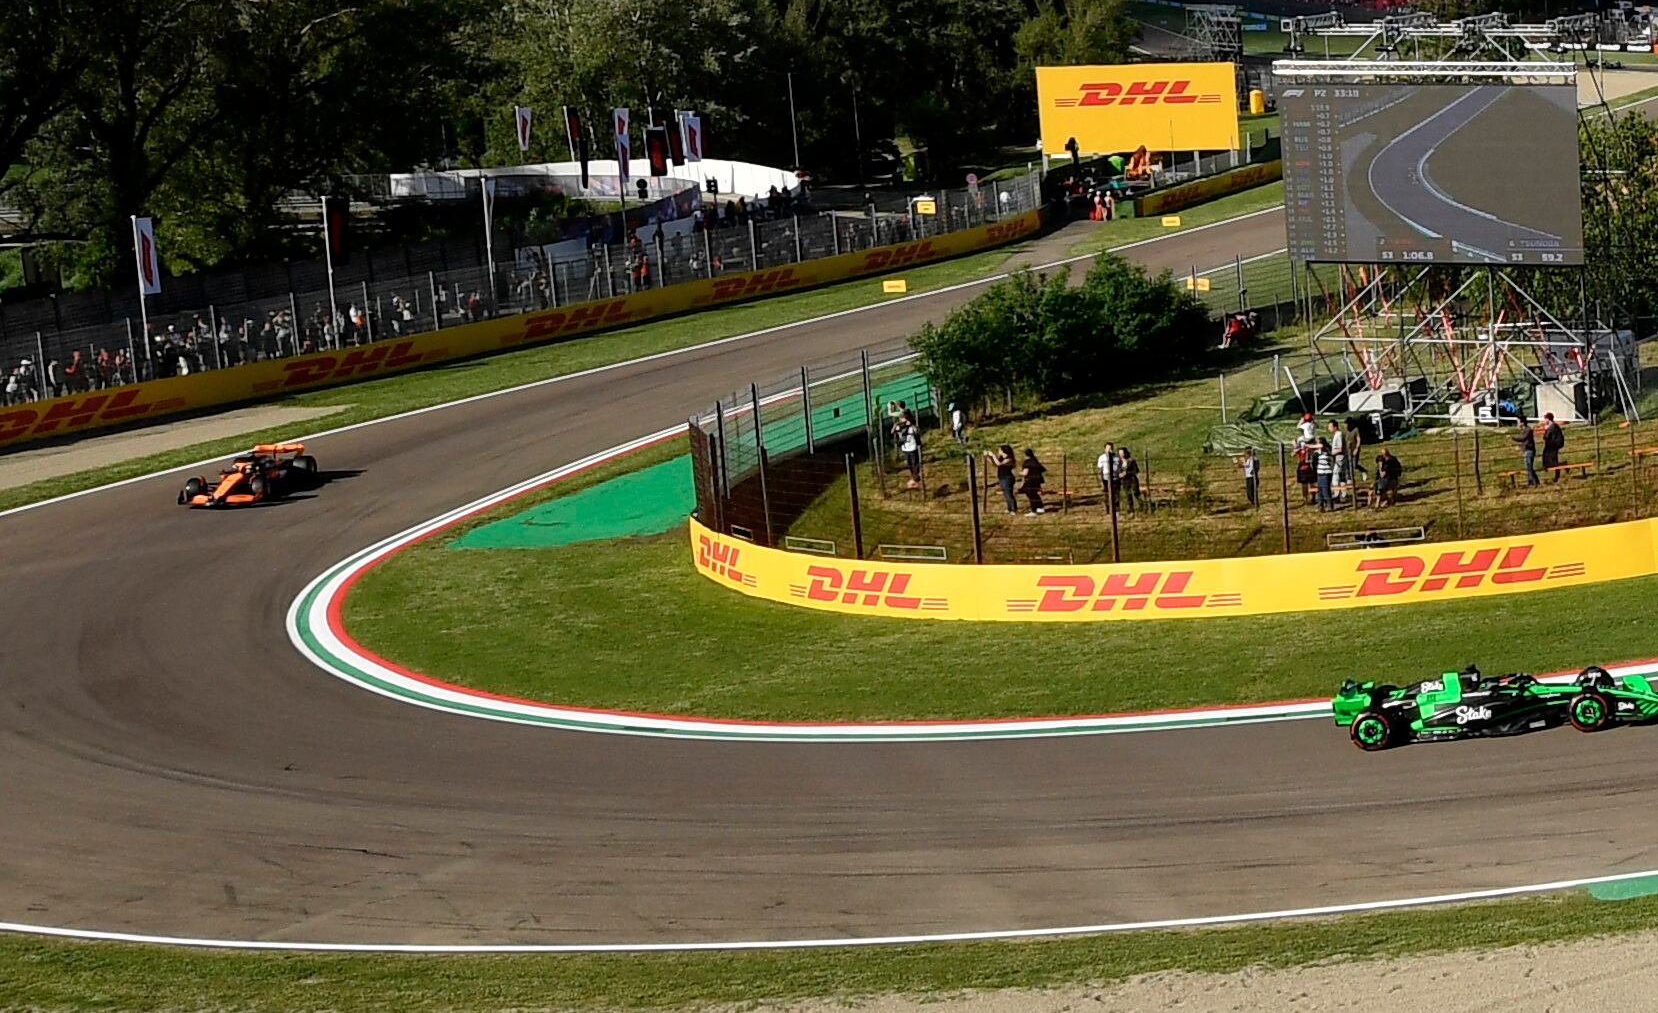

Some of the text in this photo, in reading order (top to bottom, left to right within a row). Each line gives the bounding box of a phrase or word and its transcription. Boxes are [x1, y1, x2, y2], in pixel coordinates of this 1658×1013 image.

[1078, 80, 1198, 107] DHL
[864, 241, 937, 268] DHL
[711, 269, 799, 300] DHL
[522, 300, 635, 339] DHL
[282, 341, 424, 387] DHL
[0, 389, 150, 441] DHL
[699, 534, 743, 581] DHL
[1356, 544, 1548, 597] DHL
[806, 565, 922, 609] DHL
[1037, 571, 1208, 612] DHL
[1456, 705, 1492, 724] Stake
